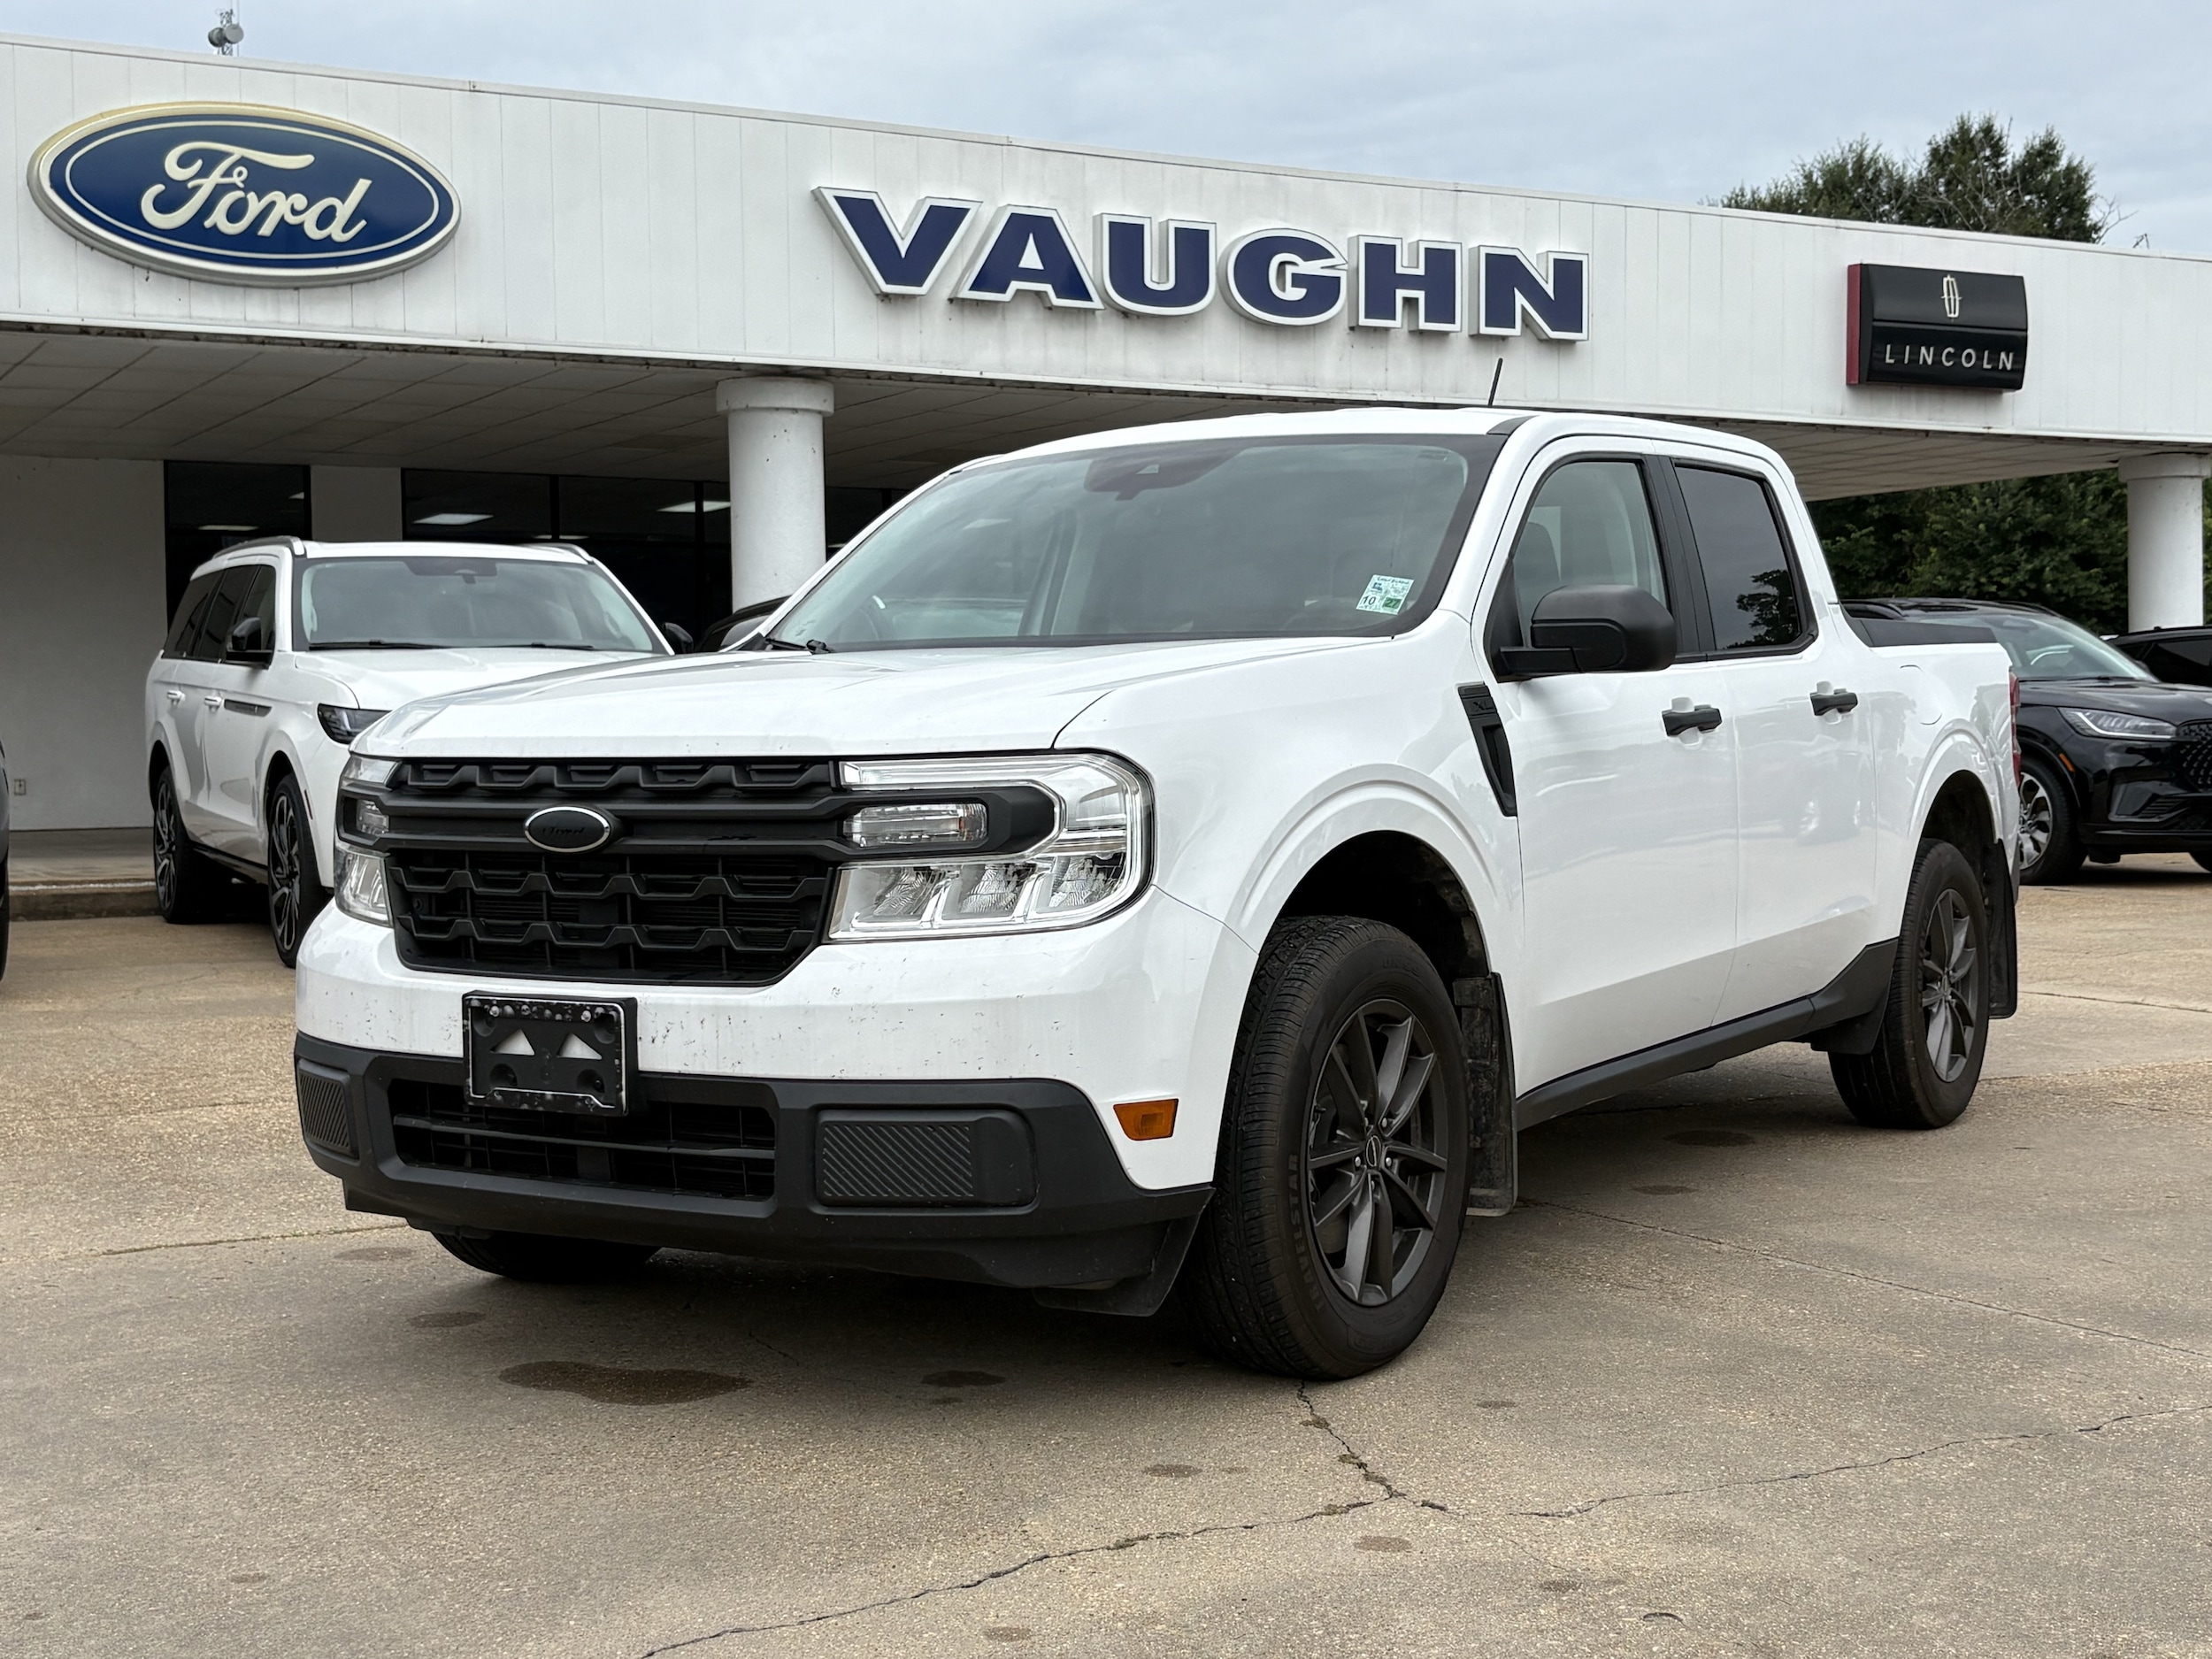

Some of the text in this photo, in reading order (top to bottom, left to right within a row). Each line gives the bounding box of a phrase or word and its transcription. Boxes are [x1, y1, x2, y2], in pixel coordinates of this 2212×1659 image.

[141, 141, 373, 242] Ford
[812, 186, 1590, 342] VAUGHN
[1885, 343, 2015, 371] LINCOLN
[1363, 595, 1377, 606] 10
[1384, 598, 1401, 609] 27
[1472, 699, 1494, 712] XL
